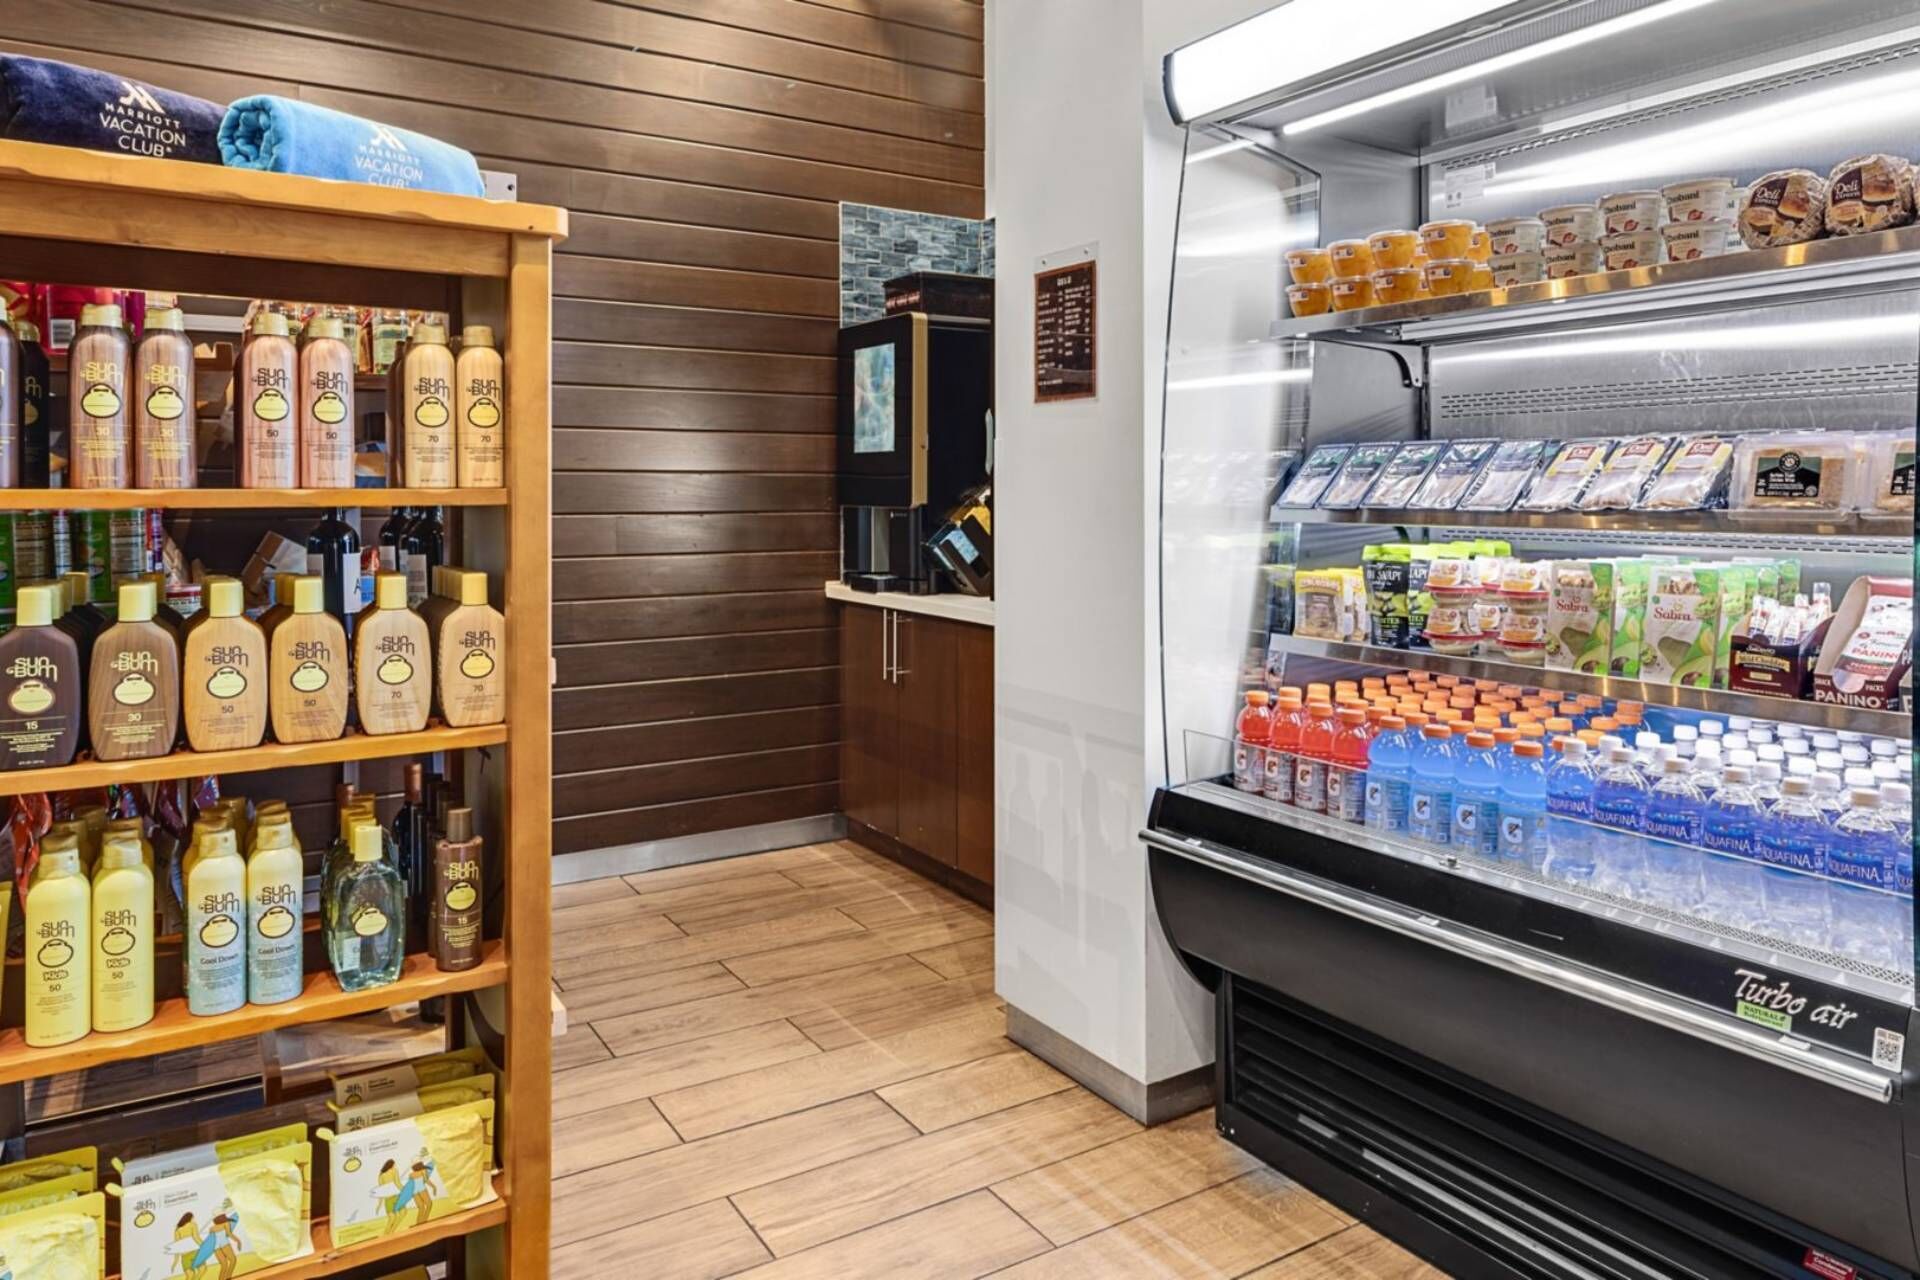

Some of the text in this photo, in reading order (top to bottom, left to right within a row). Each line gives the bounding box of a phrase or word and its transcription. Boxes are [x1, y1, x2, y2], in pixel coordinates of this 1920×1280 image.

[105, 102, 181, 129] MARRIOTT
[99, 111, 186, 147] VACATION
[353, 154, 424, 182] VACATION
[267, 429, 279, 437] 50
[326, 432, 337, 440] 50
[428, 435, 439, 443] 70
[1556, 600, 1589, 613] Sabra
[1654, 608, 1691, 621] Sabra
[391, 691, 402, 699] 70
[1816, 689, 1881, 708] PANINO
[304, 699, 316, 707] 50
[221, 705, 233, 714] 50
[127, 713, 141, 721] 30
[26, 721, 38, 730] 15
[112, 972, 124, 980] 50
[49, 984, 61, 993] 50
[1734, 968, 1859, 1030] Turbo air
